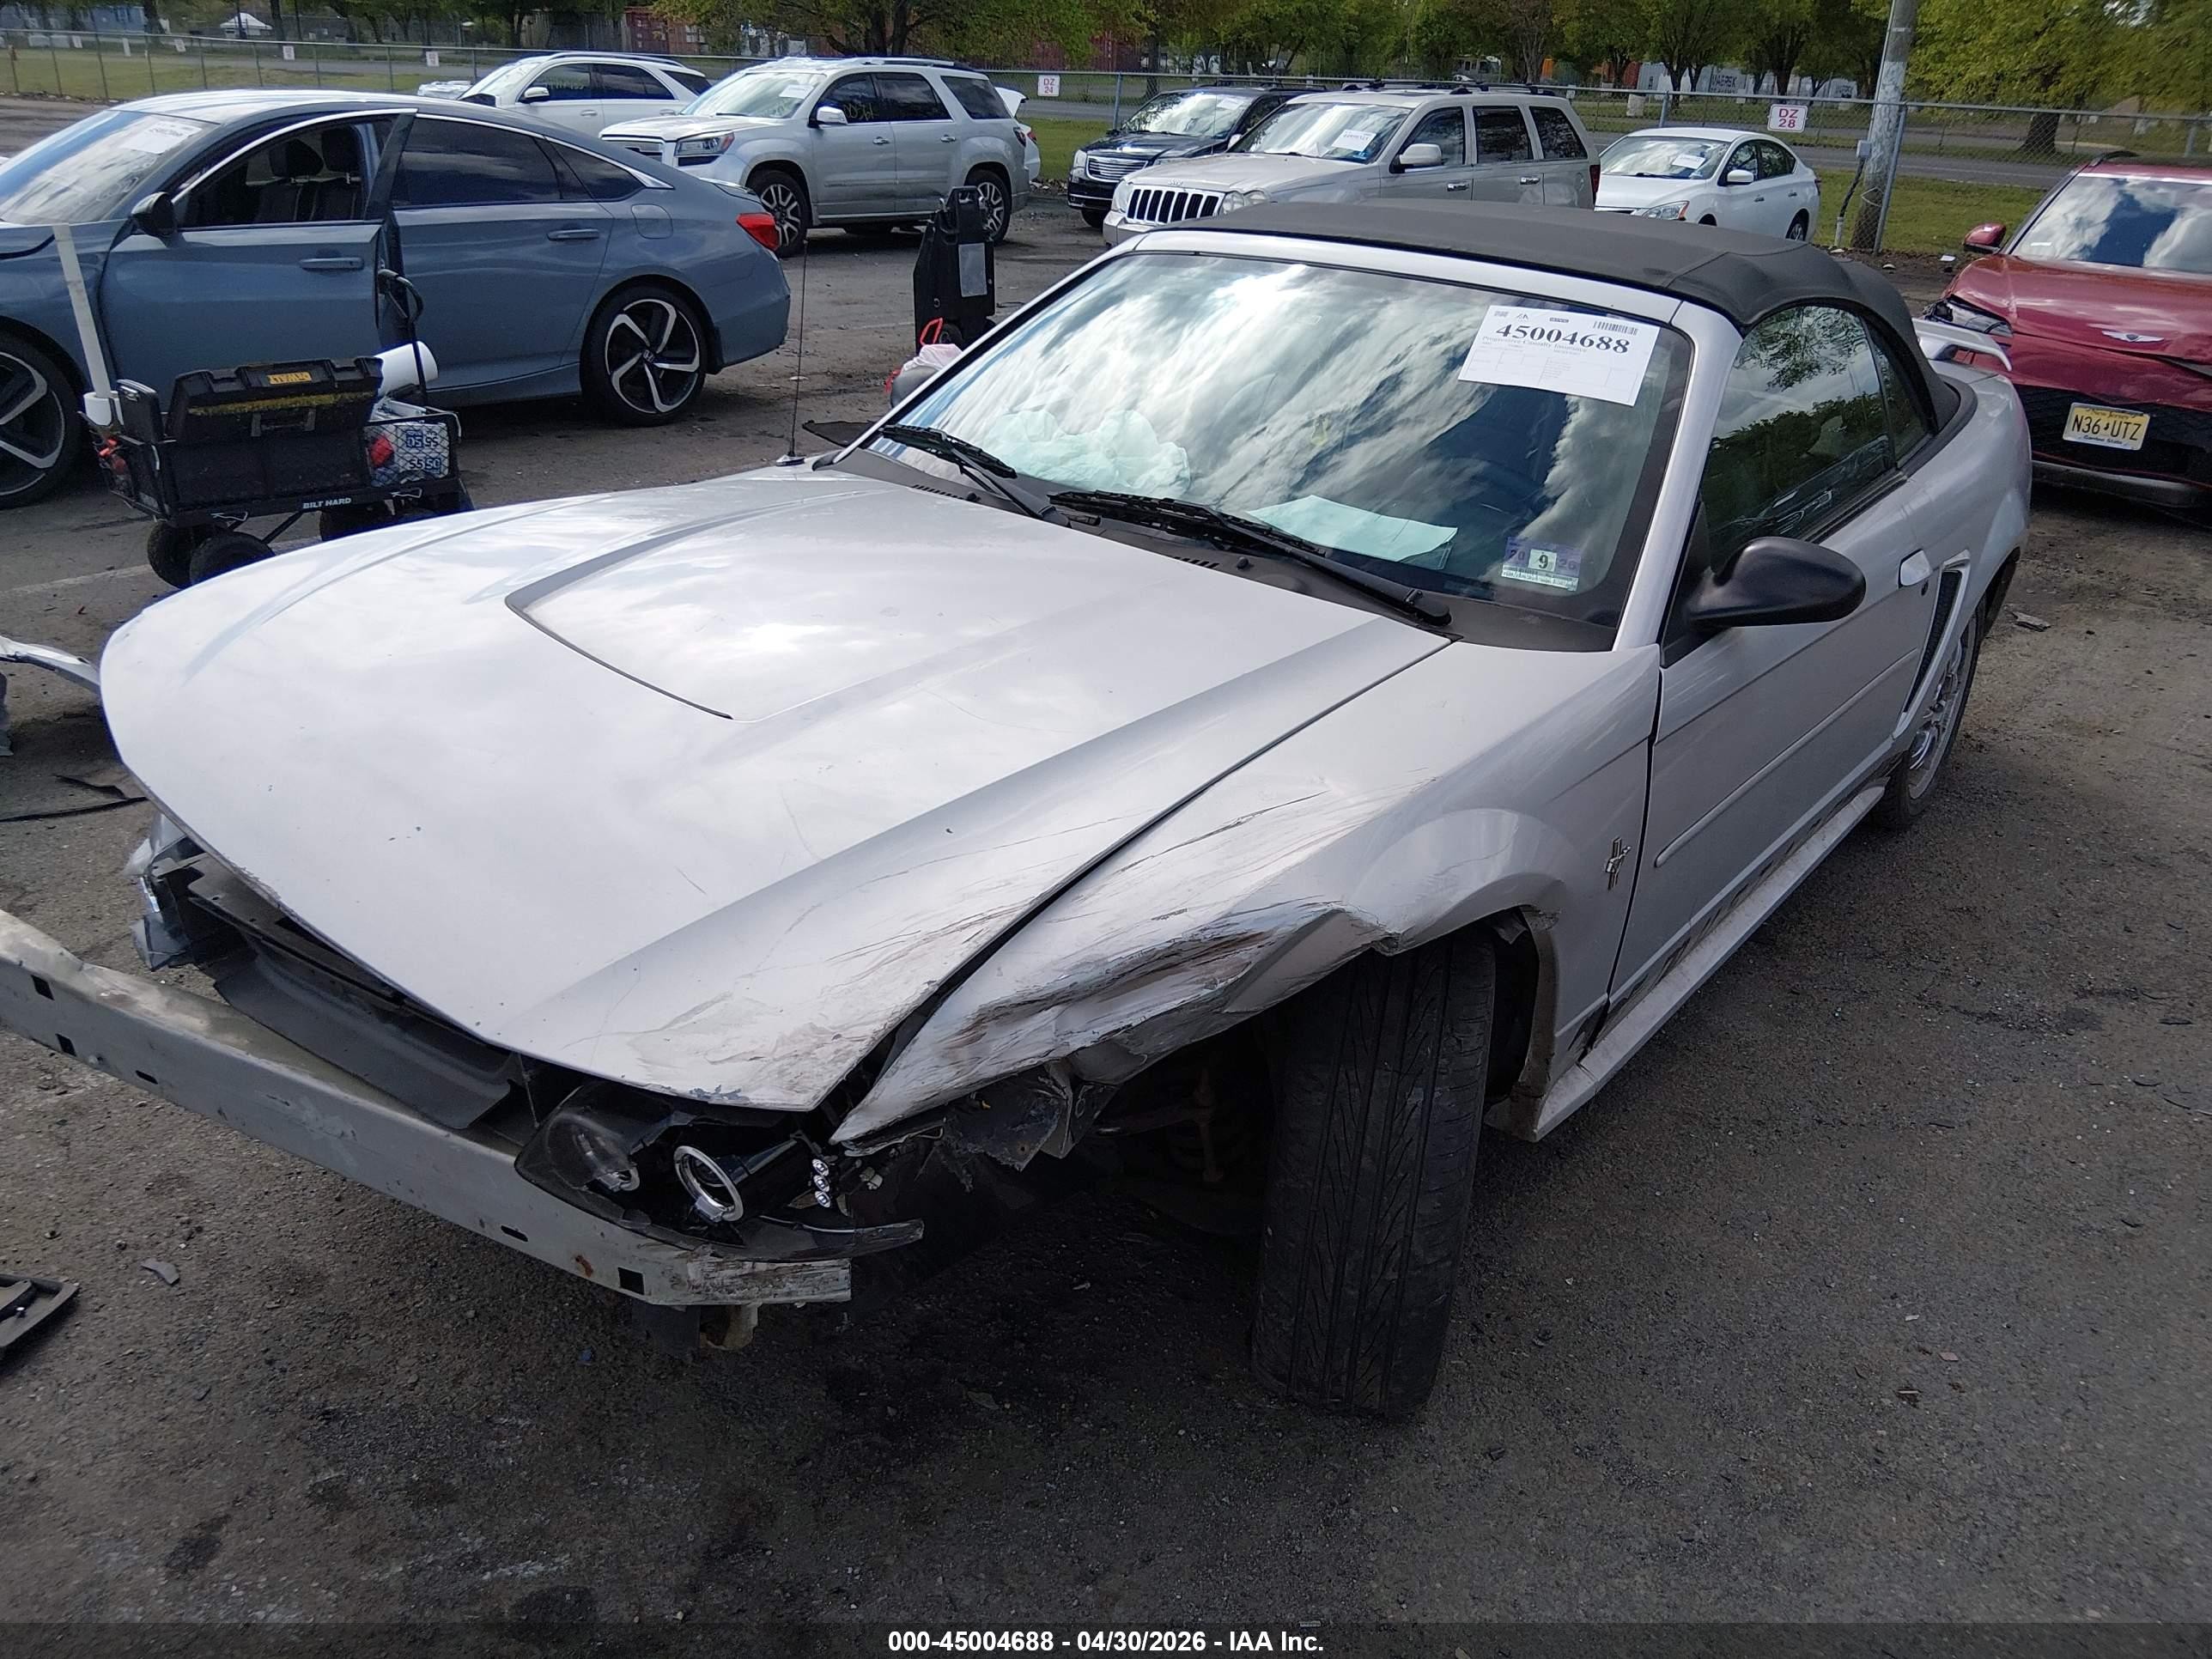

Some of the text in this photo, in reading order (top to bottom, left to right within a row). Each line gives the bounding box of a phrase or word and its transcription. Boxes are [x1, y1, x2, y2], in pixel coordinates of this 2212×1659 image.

[1778, 108, 1799, 118] DZ
[1778, 118, 1796, 128] 28
[1496, 324, 1630, 354] 45004688
[2071, 414, 2142, 441] N36 UTZ
[325, 497, 352, 507] HARD
[1538, 554, 1549, 569] 9
